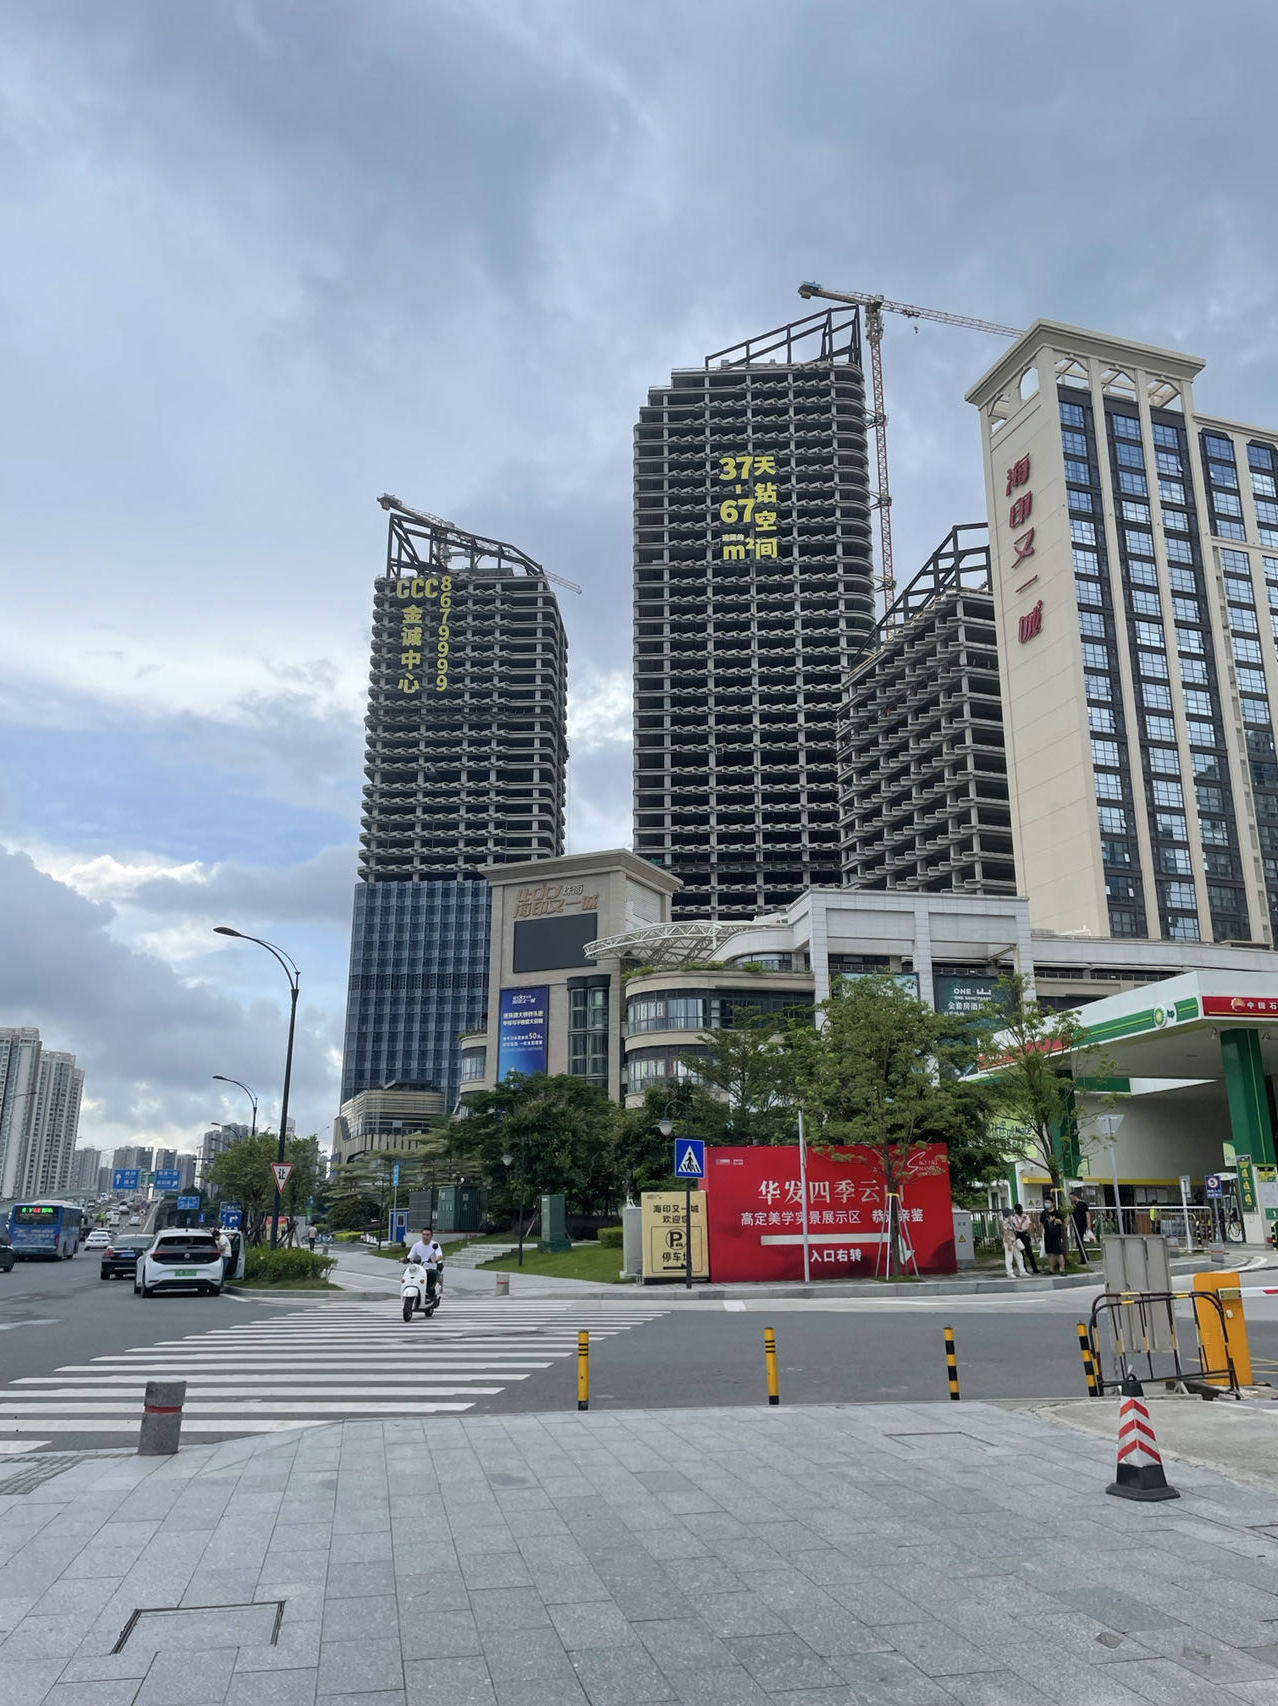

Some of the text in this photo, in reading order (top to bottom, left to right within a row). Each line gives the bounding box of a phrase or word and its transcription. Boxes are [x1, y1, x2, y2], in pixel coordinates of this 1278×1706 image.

[719, 456, 753, 480] 37
[720, 499, 756, 523] 67
[436, 575, 452, 692] 8679999
[653, 1205, 699, 1213] 海印又一城
[740, 1207, 924, 1226] 高定美学实景展示区 恭亲鉴
[810, 1248, 862, 1262] 入口右转
